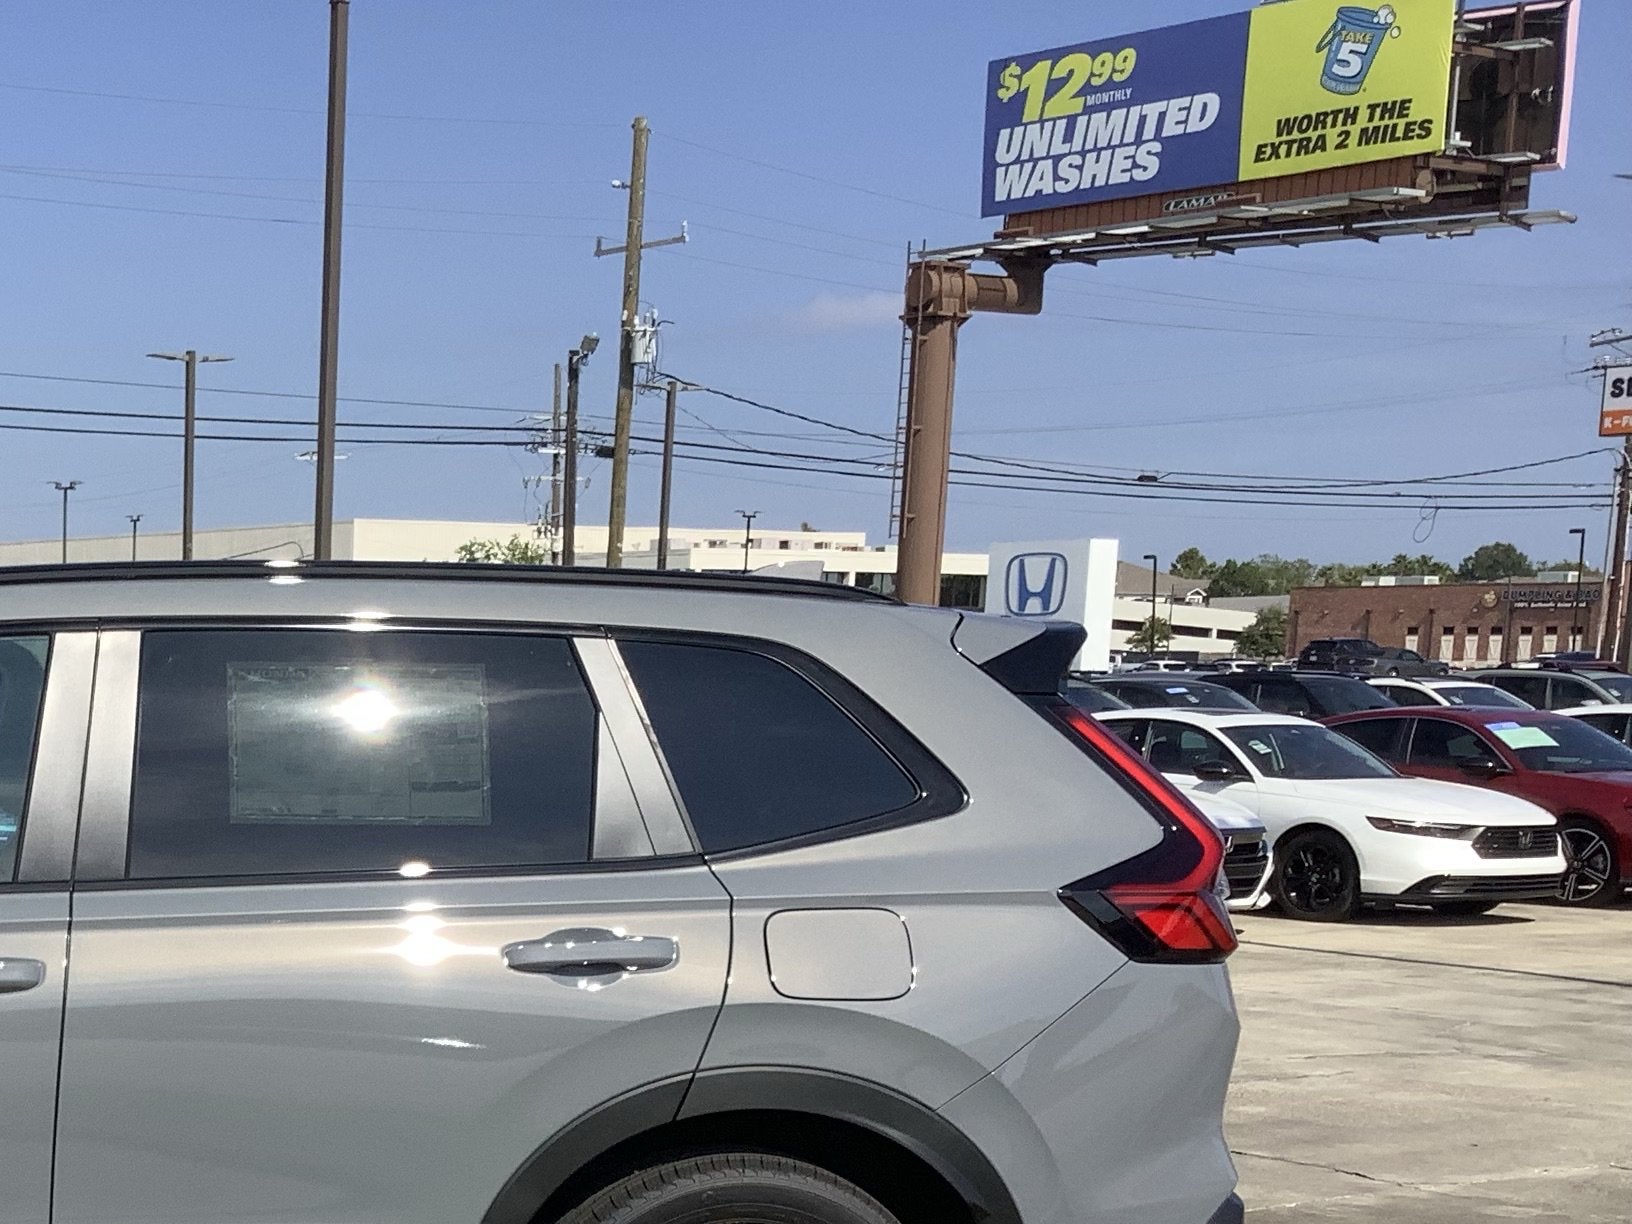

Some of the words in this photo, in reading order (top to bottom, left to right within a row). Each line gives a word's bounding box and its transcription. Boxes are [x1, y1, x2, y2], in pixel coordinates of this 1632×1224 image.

[1339, 30, 1376, 45] TAKE
[1331, 42, 1369, 78] 5
[1085, 87, 1133, 107] MONTHLY
[994, 91, 1221, 165] UNLIMITED
[1276, 105, 1360, 139] WORTH
[1366, 97, 1413, 128] THE
[1253, 134, 1328, 164] EXTRA
[1333, 129, 1351, 151] 2
[1356, 118, 1434, 148] MILES
[994, 140, 1163, 203] WASHES
[1502, 589, 1562, 600] DUMPLING
